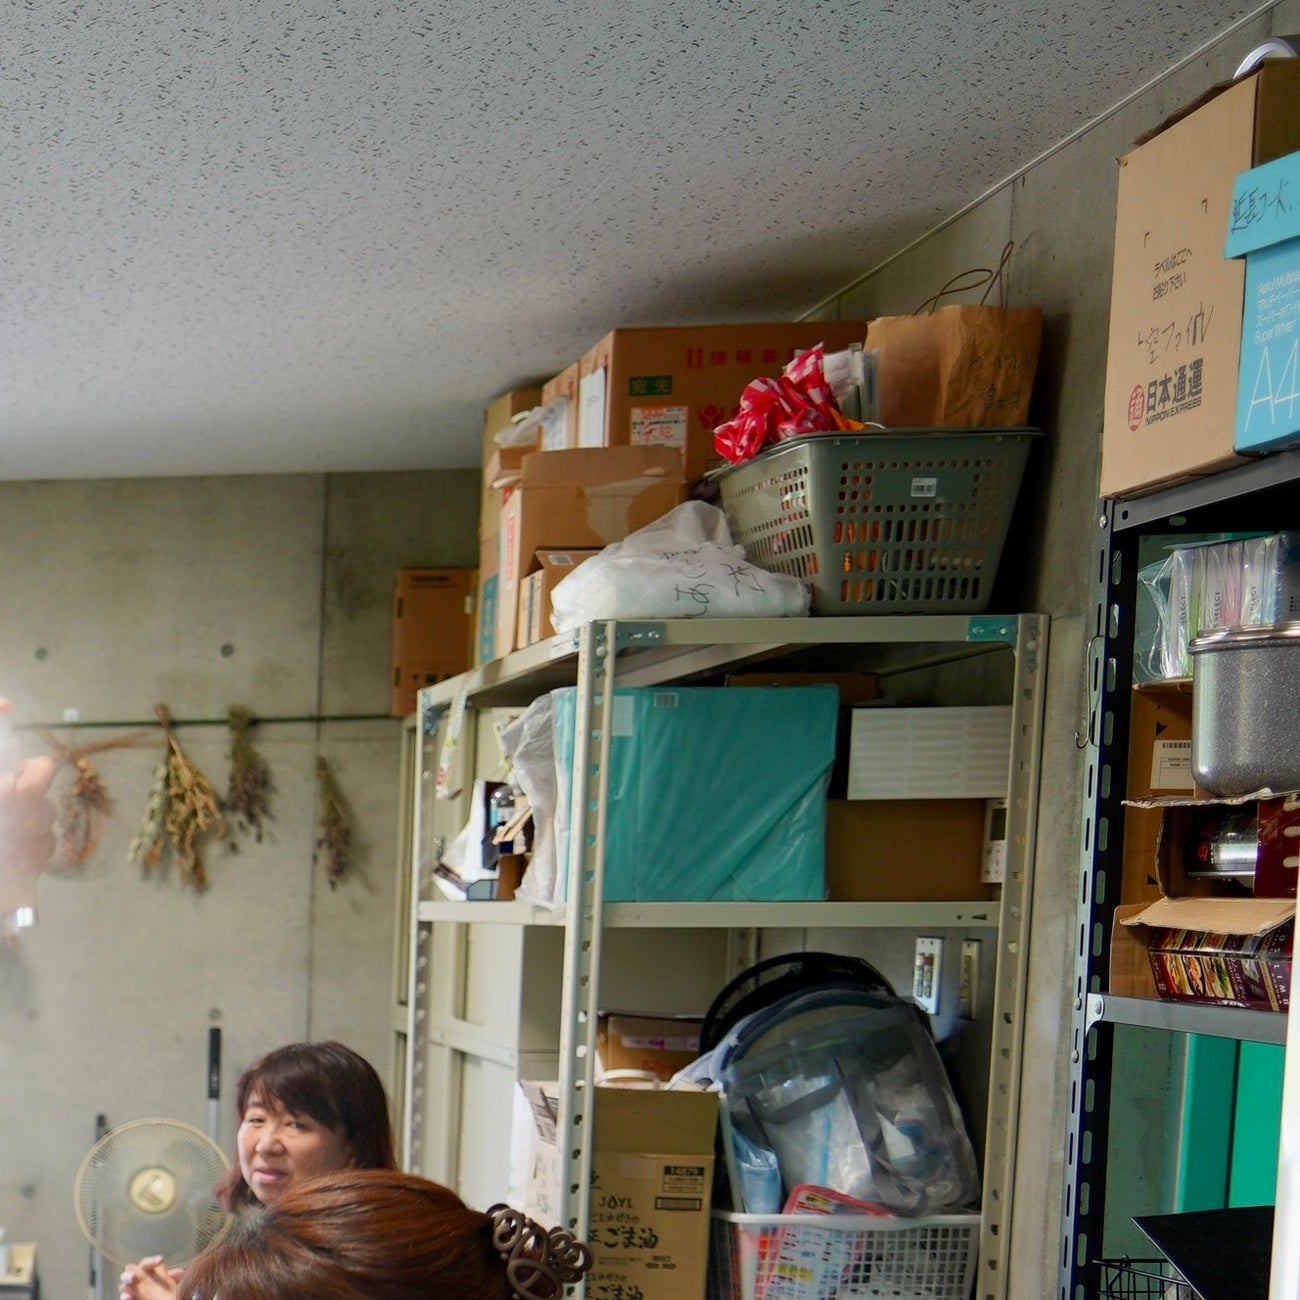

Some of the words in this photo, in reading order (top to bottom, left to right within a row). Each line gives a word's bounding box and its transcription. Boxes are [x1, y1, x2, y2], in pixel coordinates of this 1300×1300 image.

[1145, 407, 1170, 427] NIPPON
[1170, 398, 1202, 417] EXPRESS
[1146, 357, 1204, 415] 日本通運
[1244, 338, 1300, 432] A4
